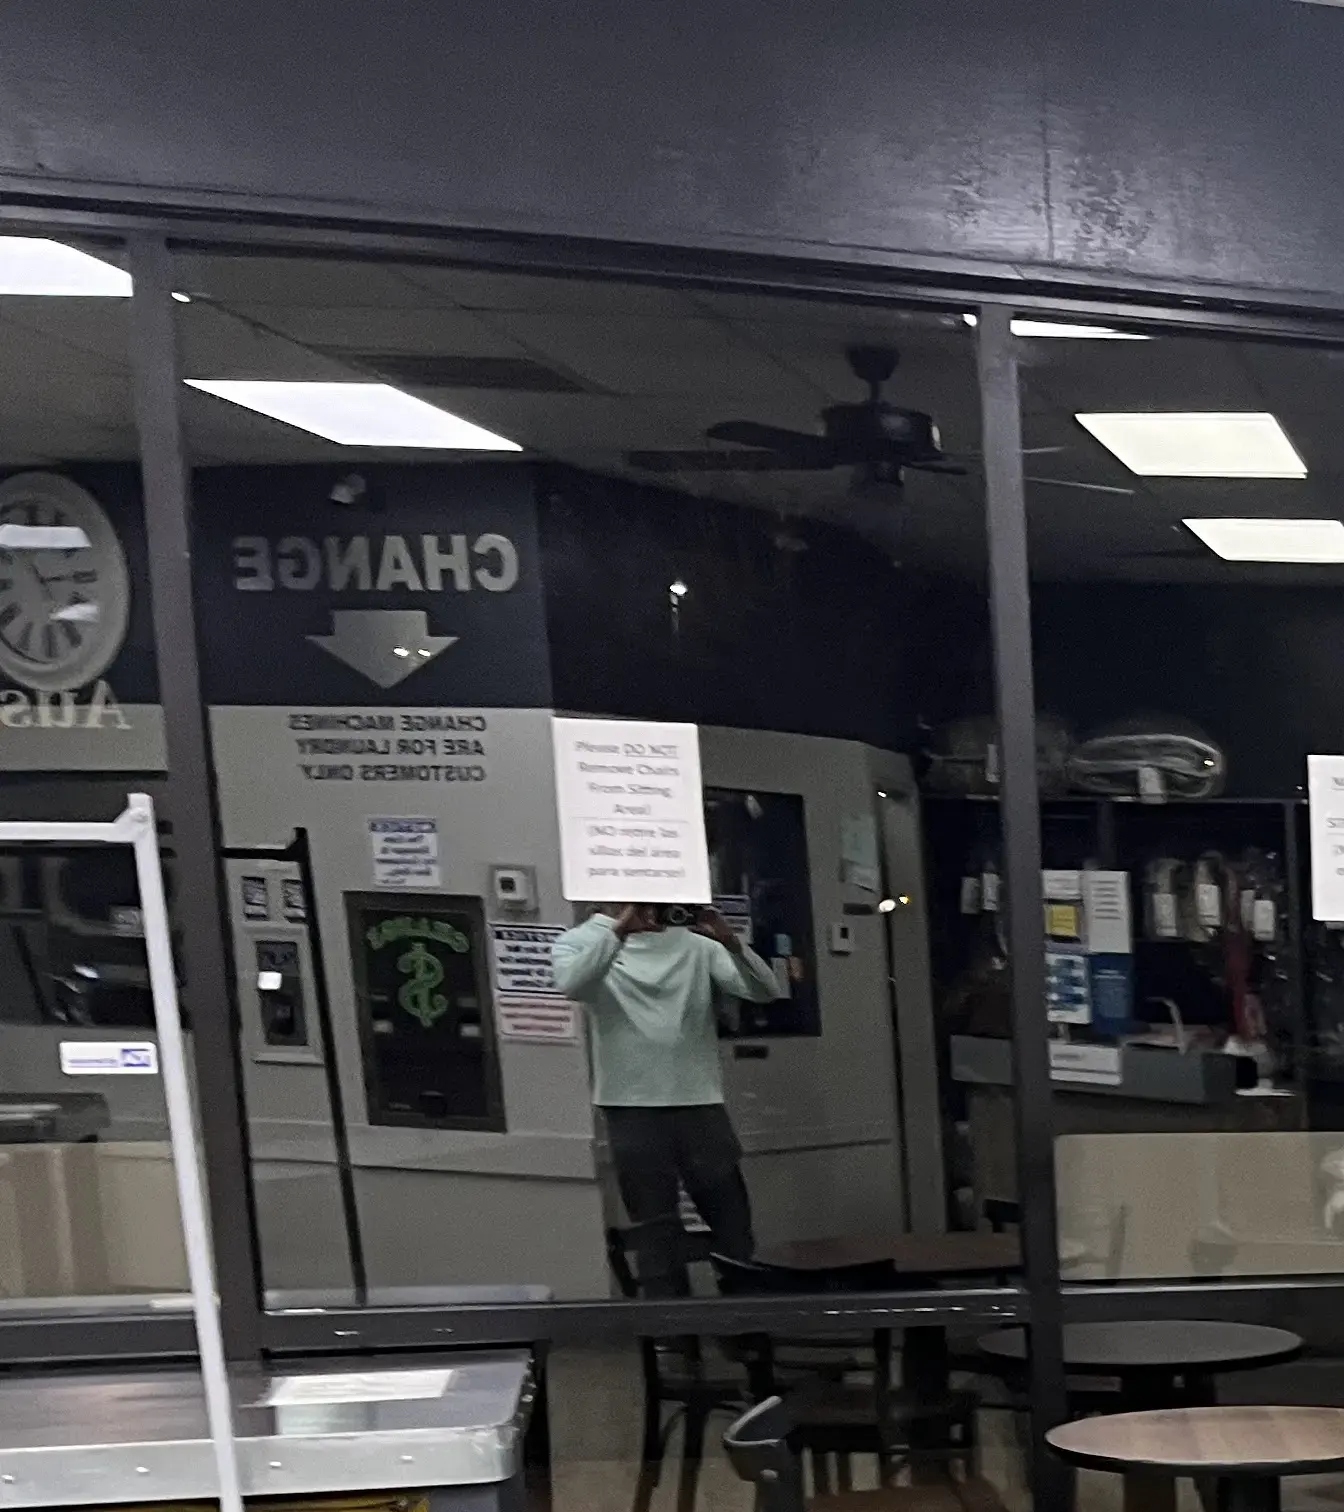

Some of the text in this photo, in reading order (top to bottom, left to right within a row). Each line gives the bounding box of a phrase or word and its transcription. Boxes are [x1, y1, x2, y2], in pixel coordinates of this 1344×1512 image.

[574, 741, 679, 756] Please DO NOT
[578, 761, 679, 776] Remove Chairs
[587, 782, 625, 793] From
